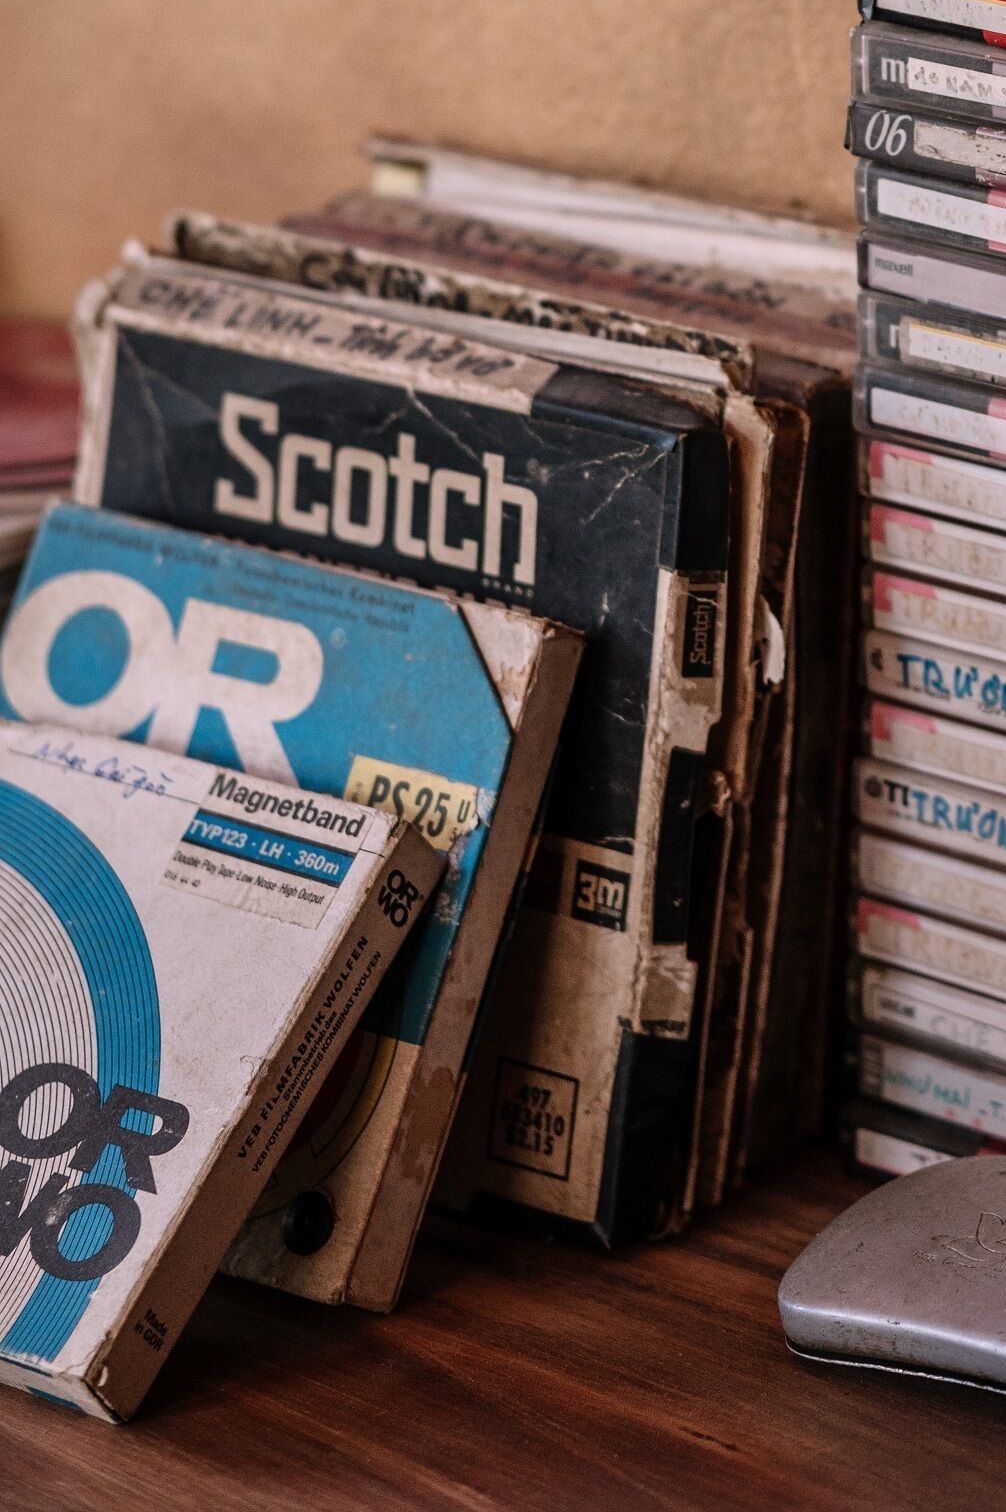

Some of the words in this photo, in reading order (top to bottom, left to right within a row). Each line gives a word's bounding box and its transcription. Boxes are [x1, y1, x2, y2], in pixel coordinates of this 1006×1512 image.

[874, 256, 914, 277] maxell
[213, 392, 539, 586] Scotch
[208, 773, 367, 838] Magnetband
[413, 786, 452, 838] 25
[293, 850, 340, 876] 360m
[298, 887, 325, 906] Output
[323, 936, 369, 1010] WOLFEN
